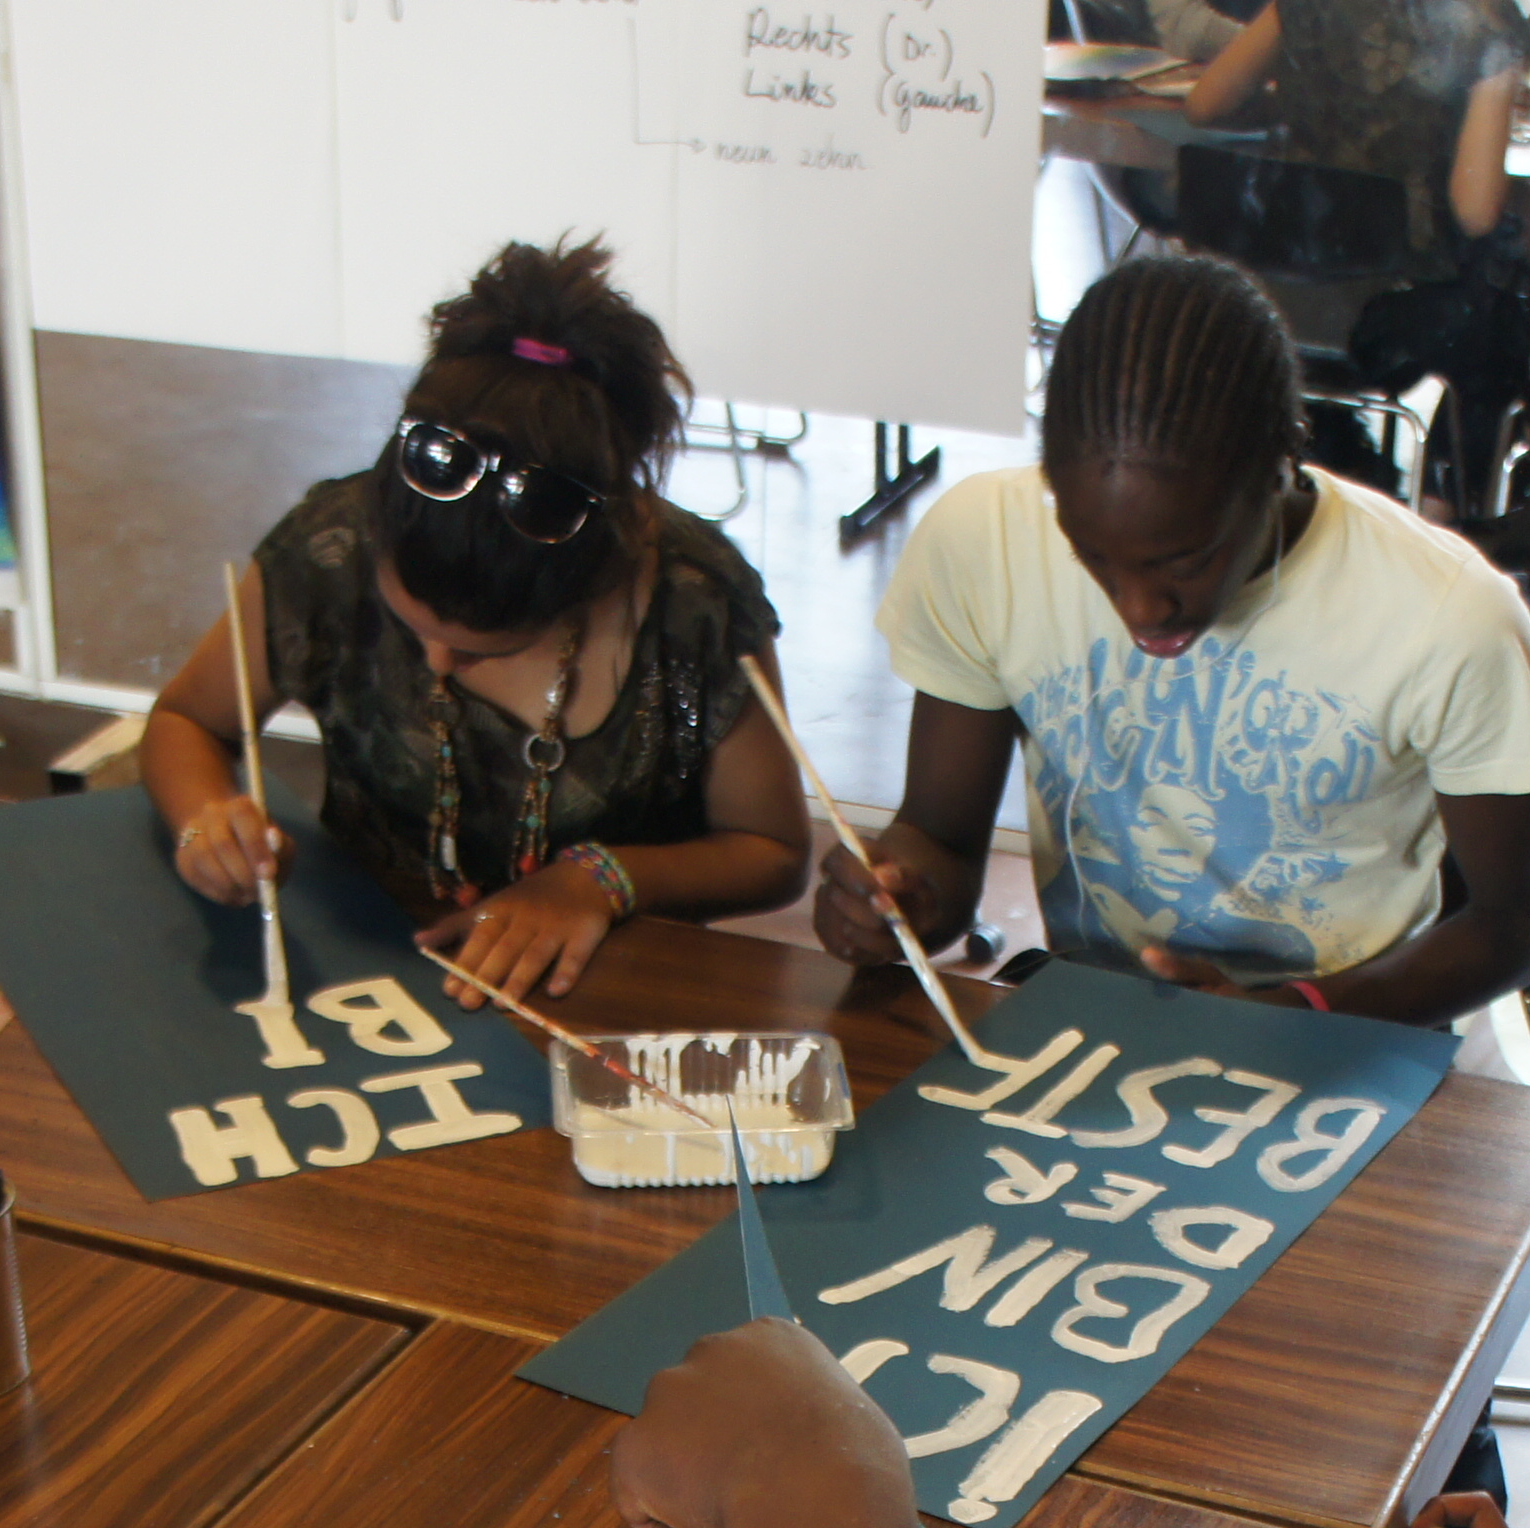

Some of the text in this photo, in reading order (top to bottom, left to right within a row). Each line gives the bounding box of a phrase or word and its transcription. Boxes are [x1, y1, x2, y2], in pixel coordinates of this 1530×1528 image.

[745, 7, 855, 59] Rechts
[745, 68, 838, 110] Links
[234, 975, 454, 1070] BI
[169, 1061, 523, 1187] ICH
[983, 1146, 1275, 1270] DER
[817, 1223, 1212, 1364] BIN
